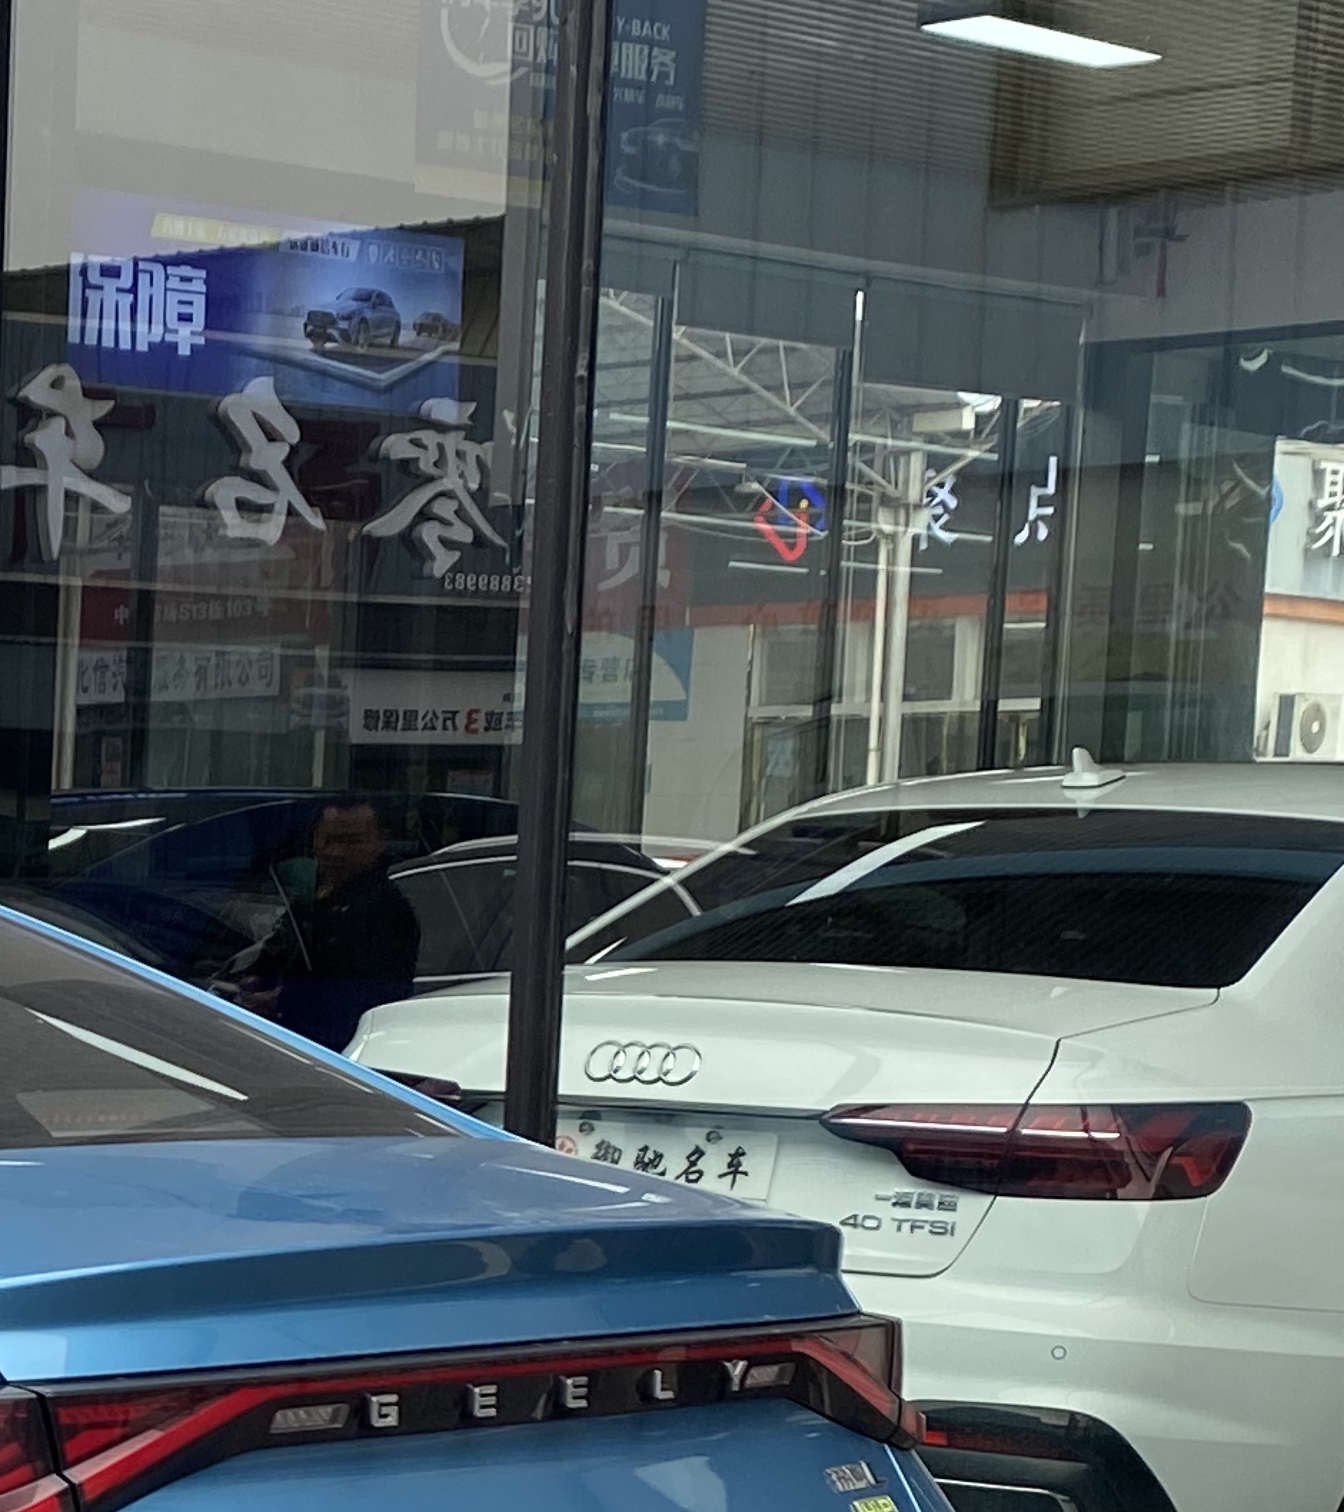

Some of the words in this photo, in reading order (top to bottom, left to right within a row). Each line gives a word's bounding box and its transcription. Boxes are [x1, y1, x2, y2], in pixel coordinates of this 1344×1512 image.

[67, 251, 207, 356] 保障
[838, 1213, 883, 1231] 40
[890, 1216, 958, 1237] TFSI
[368, 1359, 748, 1428] GEELY
